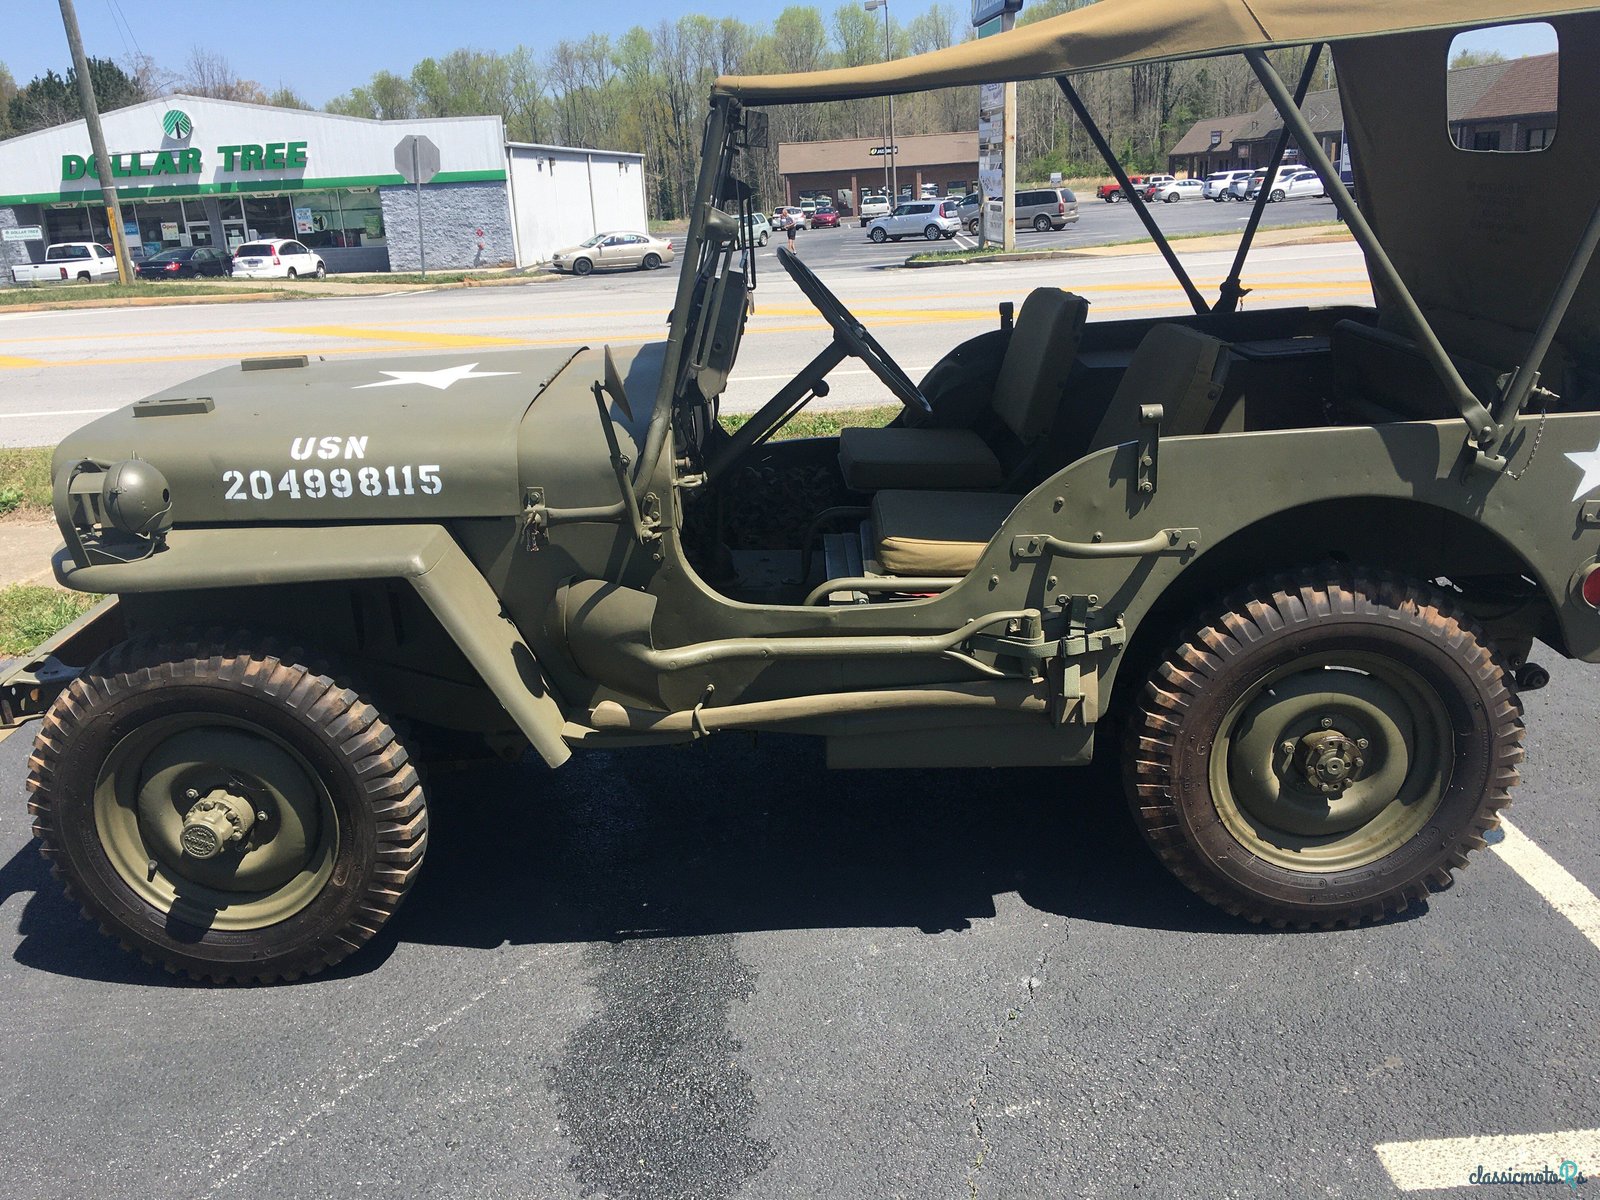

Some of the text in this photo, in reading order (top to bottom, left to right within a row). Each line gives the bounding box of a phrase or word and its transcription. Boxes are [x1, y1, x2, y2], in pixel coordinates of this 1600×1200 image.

[217, 142, 308, 172] TREE
[290, 436, 369, 460] USN
[222, 464, 443, 500] 204998115
